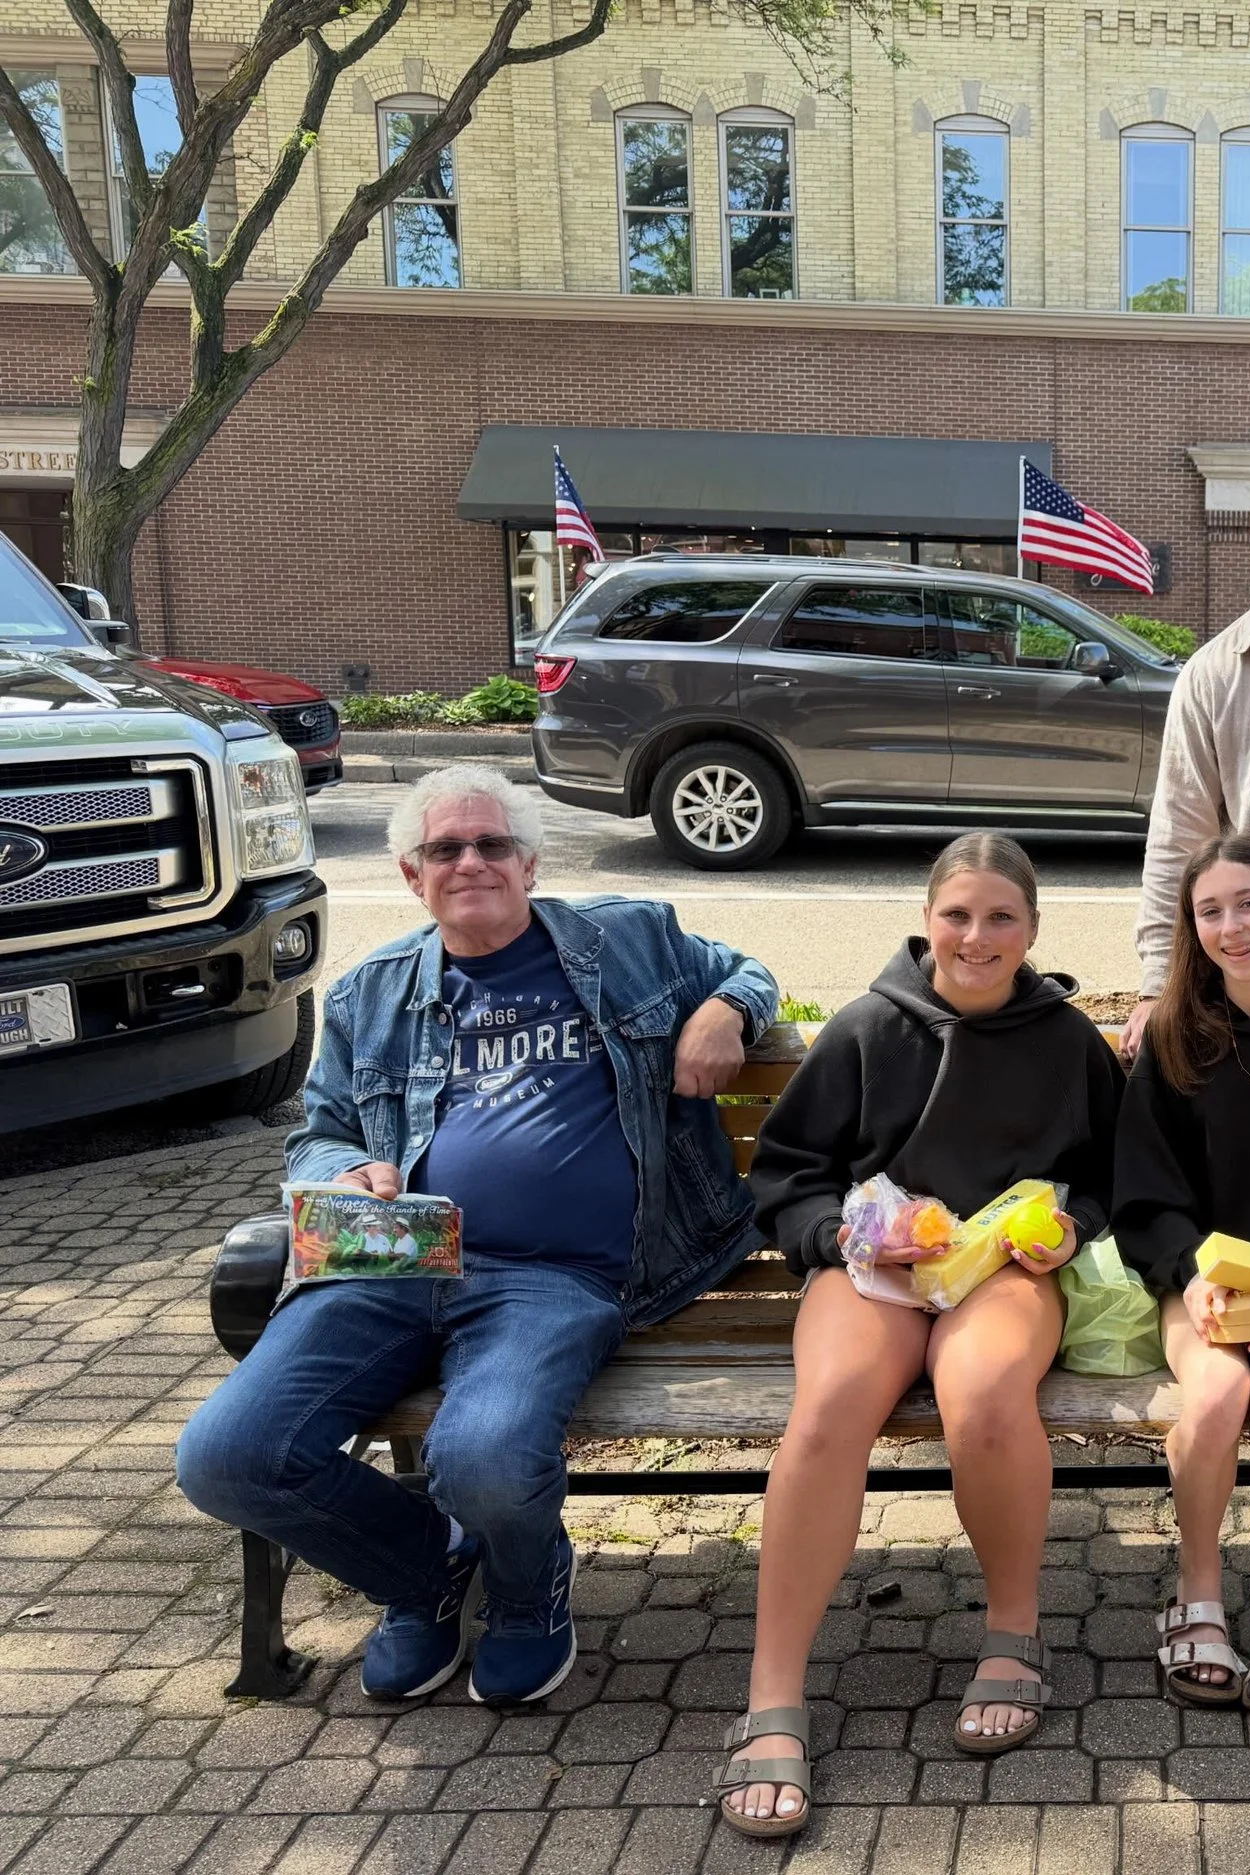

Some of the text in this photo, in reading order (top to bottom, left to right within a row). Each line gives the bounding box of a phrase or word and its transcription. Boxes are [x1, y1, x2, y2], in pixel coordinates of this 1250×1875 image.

[476, 1008, 517, 1027] 1966
[473, 1077, 555, 1109] MUSEUM
[322, 1195, 371, 1210] Never
[371, 1204, 384, 1213] the
[418, 1205, 429, 1216] of
[429, 1205, 450, 1215] Time
[977, 1194, 1023, 1226] BUTTER
